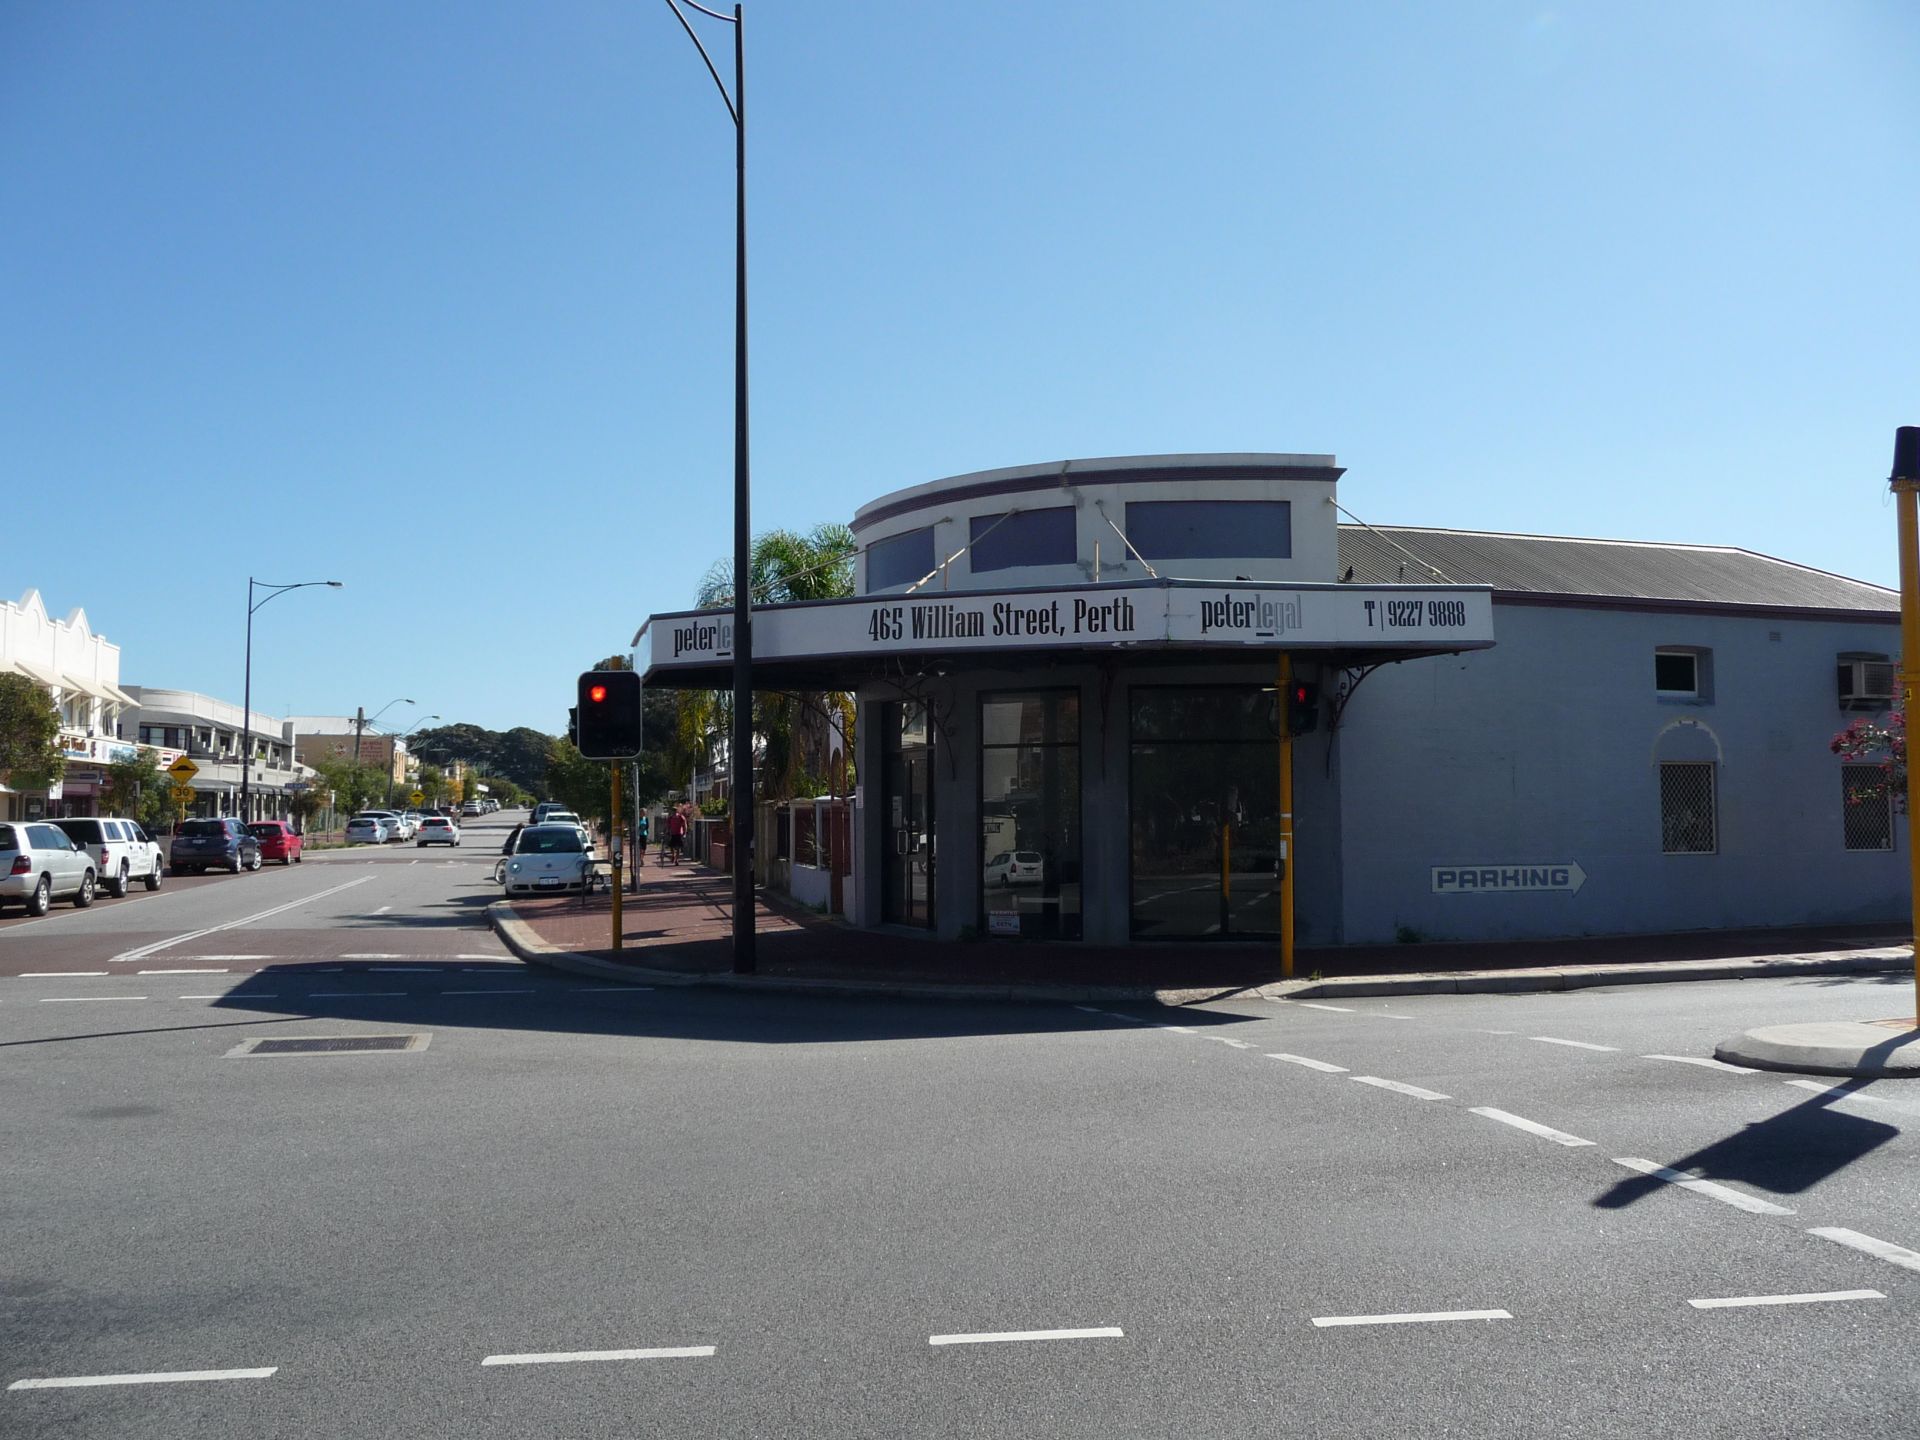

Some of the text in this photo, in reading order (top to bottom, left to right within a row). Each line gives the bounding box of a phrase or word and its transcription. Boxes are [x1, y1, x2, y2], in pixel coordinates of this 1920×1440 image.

[868, 596, 1134, 641] 465 William Street, Perth
[1200, 594, 1302, 635] peterlegal
[1364, 600, 1466, 627] T 9227 9888
[673, 618, 735, 657] peterle
[1437, 868, 1568, 888] PARKING
